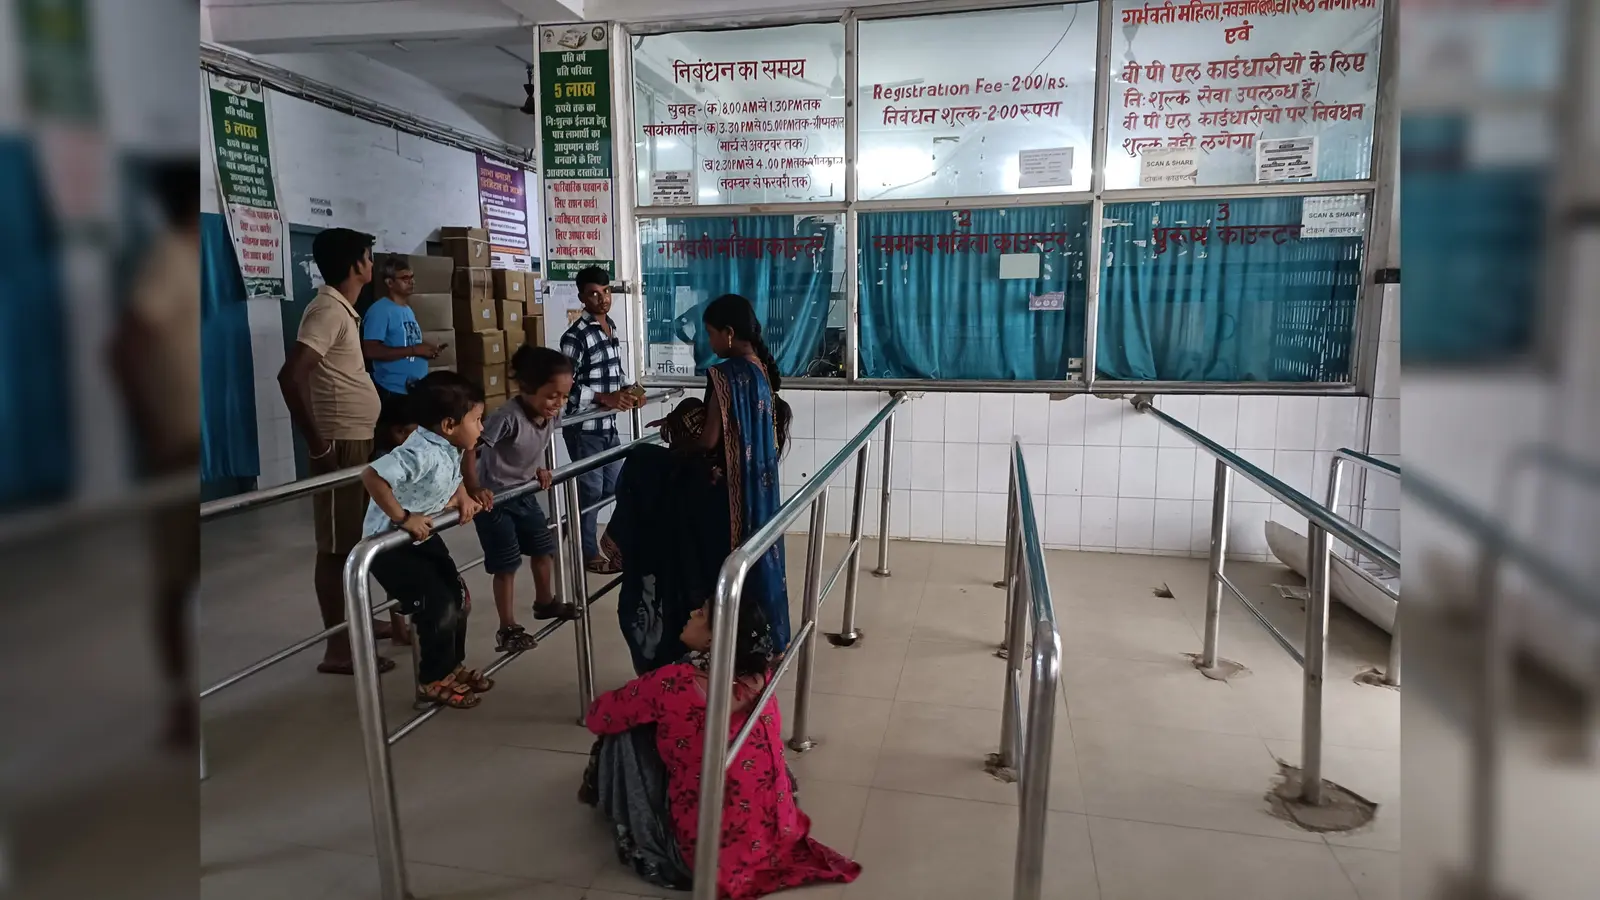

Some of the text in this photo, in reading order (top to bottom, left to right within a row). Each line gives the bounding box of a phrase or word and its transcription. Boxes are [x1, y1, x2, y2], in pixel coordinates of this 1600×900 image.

[1225, 20, 1253, 44] एवं
[571, 65, 592, 75] परिवार
[737, 61, 758, 80] का
[761, 58, 806, 80] समय
[1144, 60, 1166, 84] पी
[1170, 63, 1201, 84] एल
[1309, 51, 1327, 74] के
[1329, 50, 1367, 77] लिए
[554, 82, 595, 98] 5 लाख
[873, 83, 969, 101] Registration
[1197, 85, 1232, 108] सेवा
[573, 104, 585, 112] तक
[586, 103, 596, 112] का
[1143, 111, 1161, 129] पी
[1165, 113, 1192, 131] एल
[1285, 106, 1308, 124] पर
[224, 120, 231, 134] 5
[591, 129, 601, 138] का
[587, 153, 601, 164] लिए
[554, 197, 566, 208] लिए
[958, 209, 972, 227] 2
[555, 228, 567, 240] लिए
[657, 360, 688, 374] महिला
